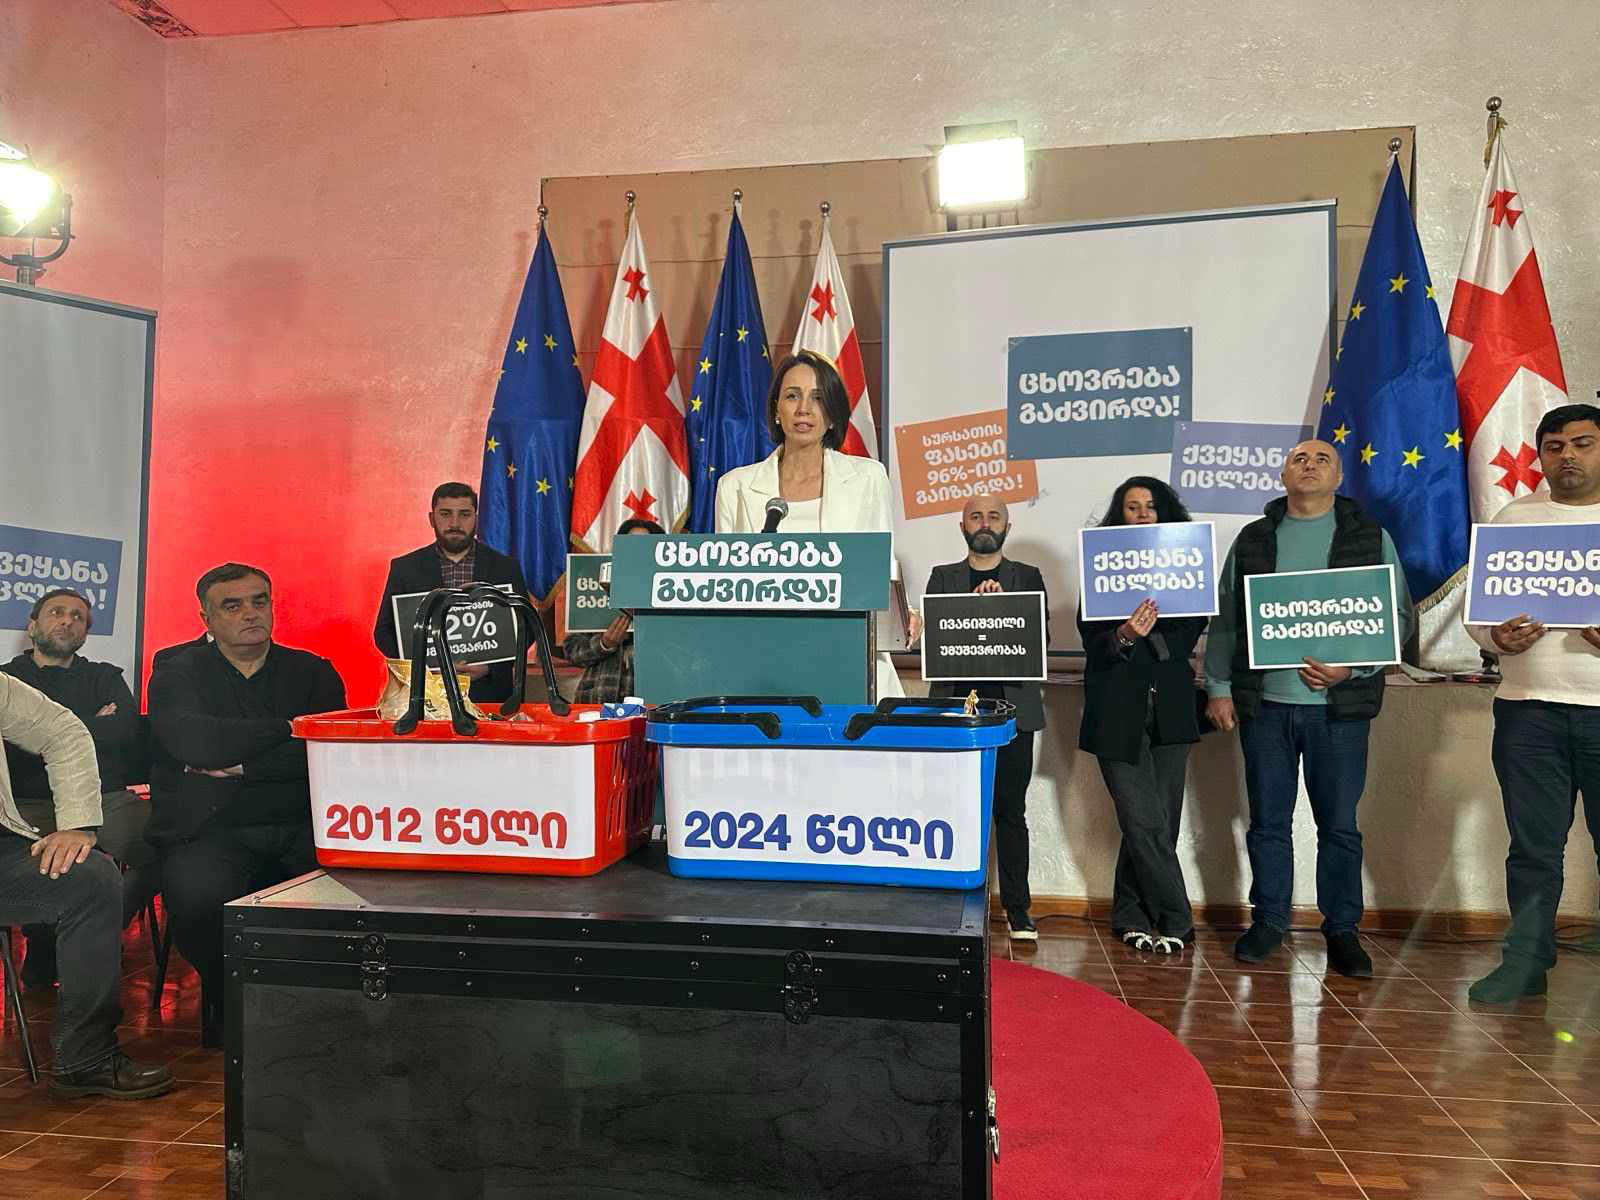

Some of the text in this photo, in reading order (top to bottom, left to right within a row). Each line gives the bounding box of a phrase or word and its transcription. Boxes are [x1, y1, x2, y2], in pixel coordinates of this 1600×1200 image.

[1019, 365, 1181, 394] ცხოვრება
[1019, 395, 1180, 424] გაძვირდა!
[922, 424, 1002, 447] სურსათის
[924, 439, 1008, 466] ფასები
[1182, 444, 1287, 468] ქვეყან
[927, 459, 1007, 486] 96%-ით
[915, 473, 1023, 505] გაიზარდა!
[654, 541, 843, 567] ცხოვრება
[1093, 547, 1204, 572] ქვეყანა
[1486, 549, 1600, 572] ქვეყან
[0, 551, 108, 584] ვეყანა
[657, 578, 837, 603] გაძვირდა!
[1094, 570, 1205, 593] იცლება!
[1484, 576, 1600, 597] იცლებ
[1259, 596, 1383, 619] ცხოვრება
[939, 617, 1026, 630] ივანიშვილი
[1261, 618, 1385, 640] გაძვირდა!
[939, 644, 1027, 656] უმუშევრობას
[326, 803, 568, 849] 2012 წელი
[684, 810, 954, 860] 2024 წელი
